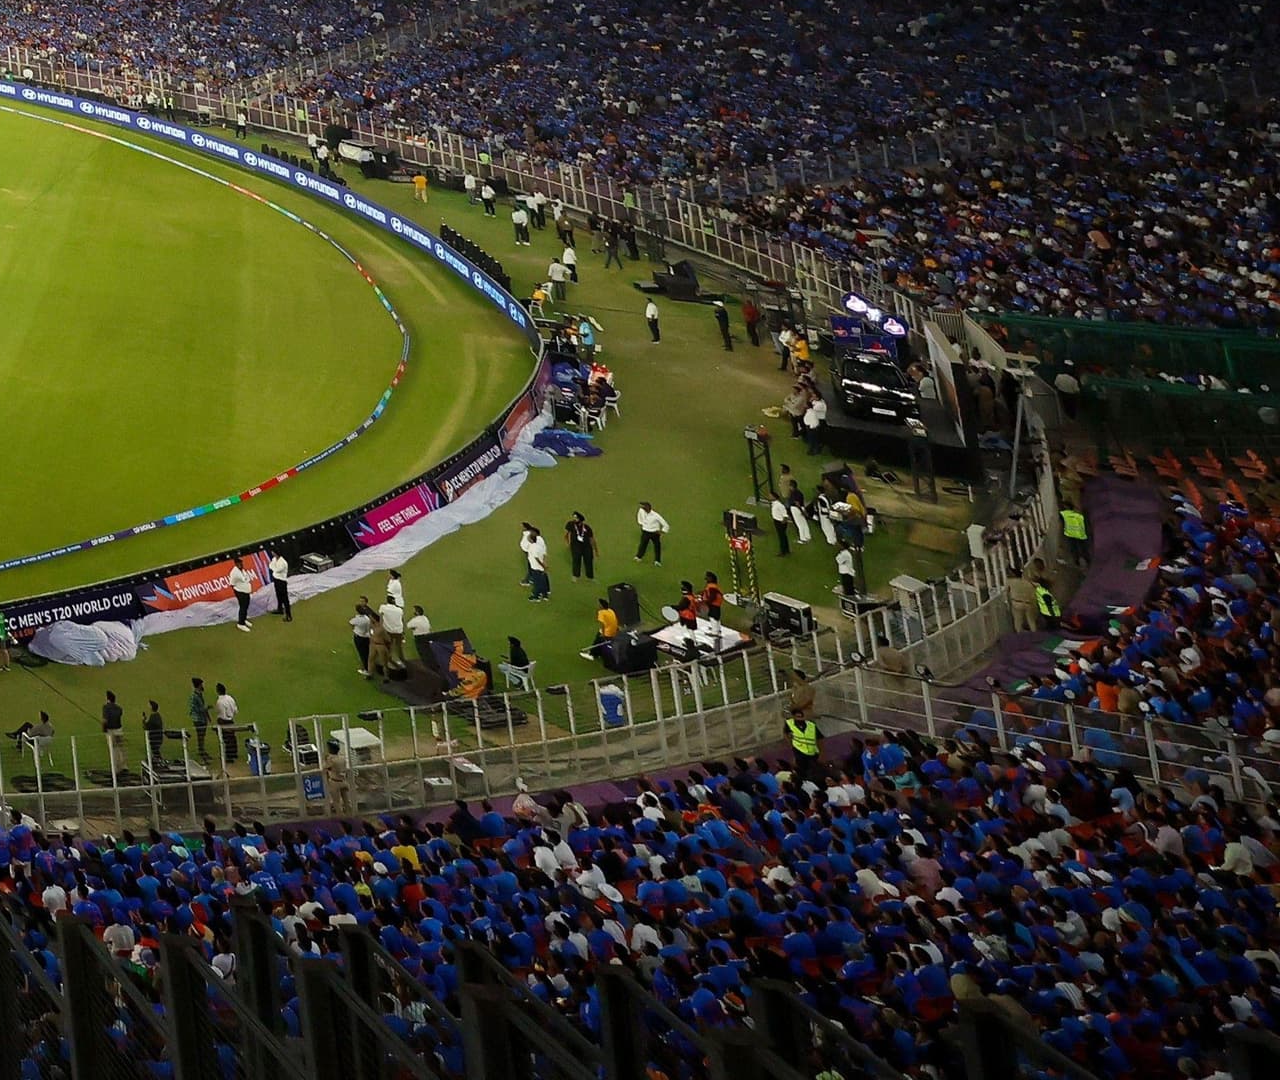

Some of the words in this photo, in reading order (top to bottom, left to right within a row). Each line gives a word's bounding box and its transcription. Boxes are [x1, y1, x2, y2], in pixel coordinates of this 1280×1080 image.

[37, 91, 74, 109] HYUNDAI
[94, 105, 131, 124] HYUNDAI
[151, 120, 186, 141] HYUNDAI
[206, 137, 239, 160] HYUNDAI
[257, 156, 290, 180] HYUNDAI
[308, 175, 340, 202] HYUNDAI
[356, 198, 386, 225] HYUNDAI
[402, 222, 432, 251] HYUNDAI
[18, 611, 52, 628] MEN'S
[52, 607, 72, 622] T20
[72, 597, 112, 617] WORLD
[112, 592, 134, 608] CUP
[305, 779, 311, 792] 3
